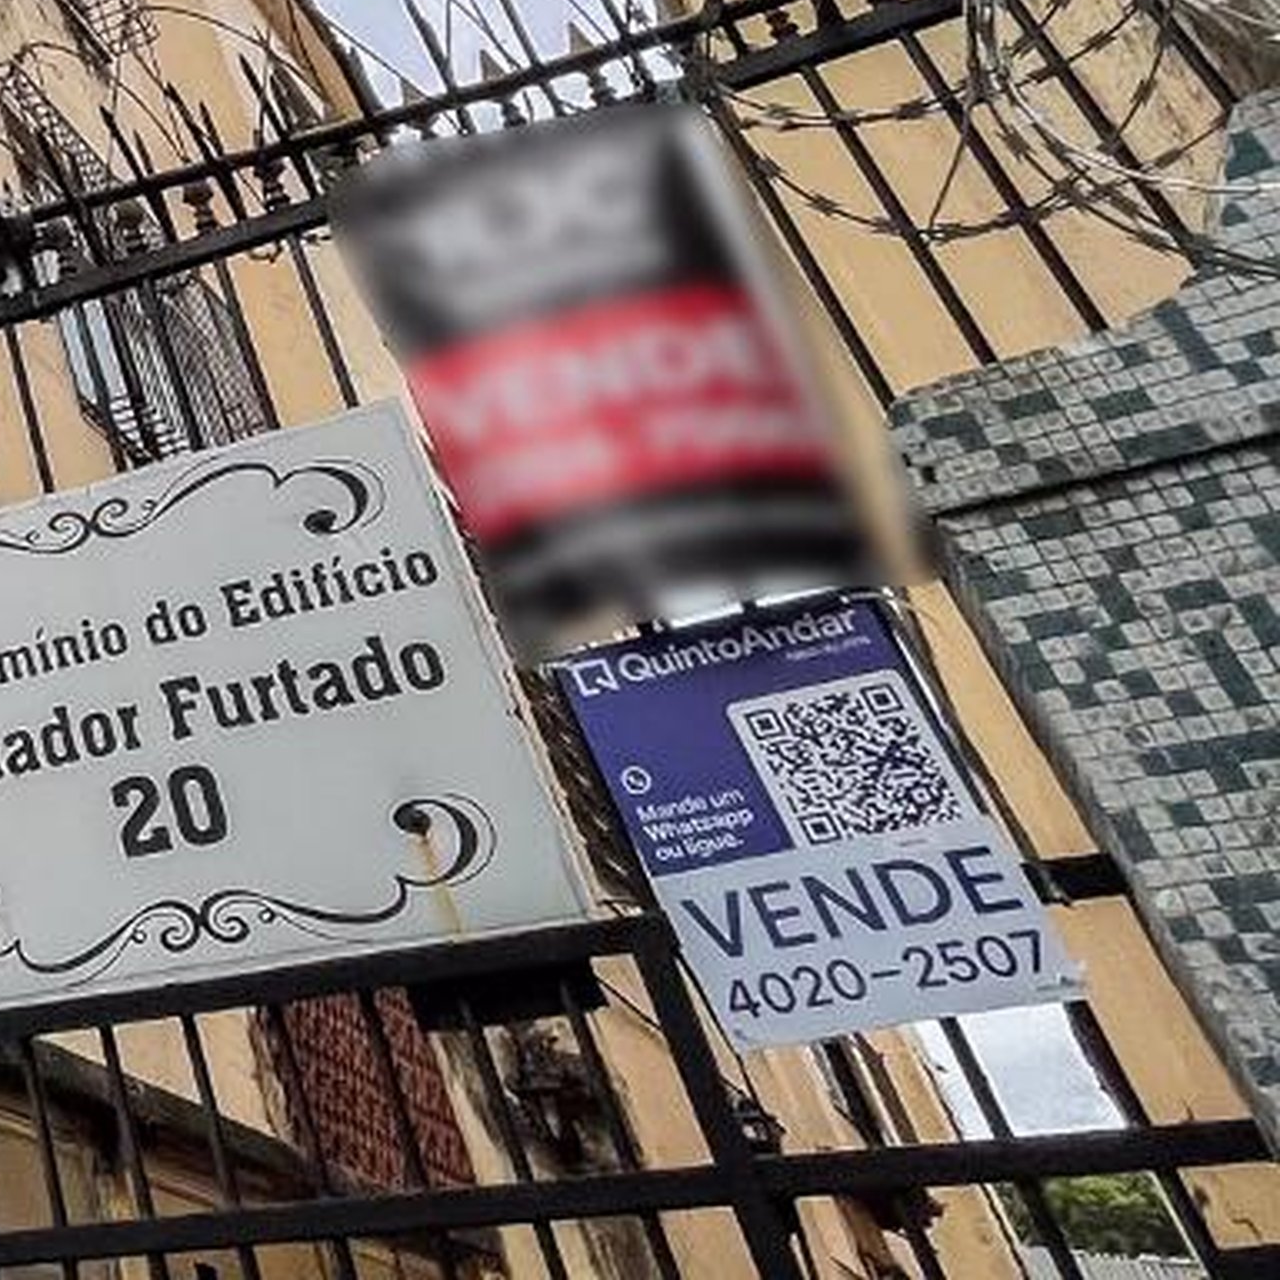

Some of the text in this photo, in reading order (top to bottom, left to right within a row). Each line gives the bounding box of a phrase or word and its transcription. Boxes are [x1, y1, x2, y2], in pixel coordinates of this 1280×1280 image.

[144, 597, 208, 646] do
[219, 546, 439, 629] Edifício
[161, 635, 446, 741] Furtado
[618, 610, 856, 682] QuintoAndar
[110, 765, 229, 859] 20
[709, 790, 744, 808] um
[655, 845, 684, 861] ou
[680, 845, 1024, 958] VENDE
[727, 929, 1041, 1019] 4020-2507
